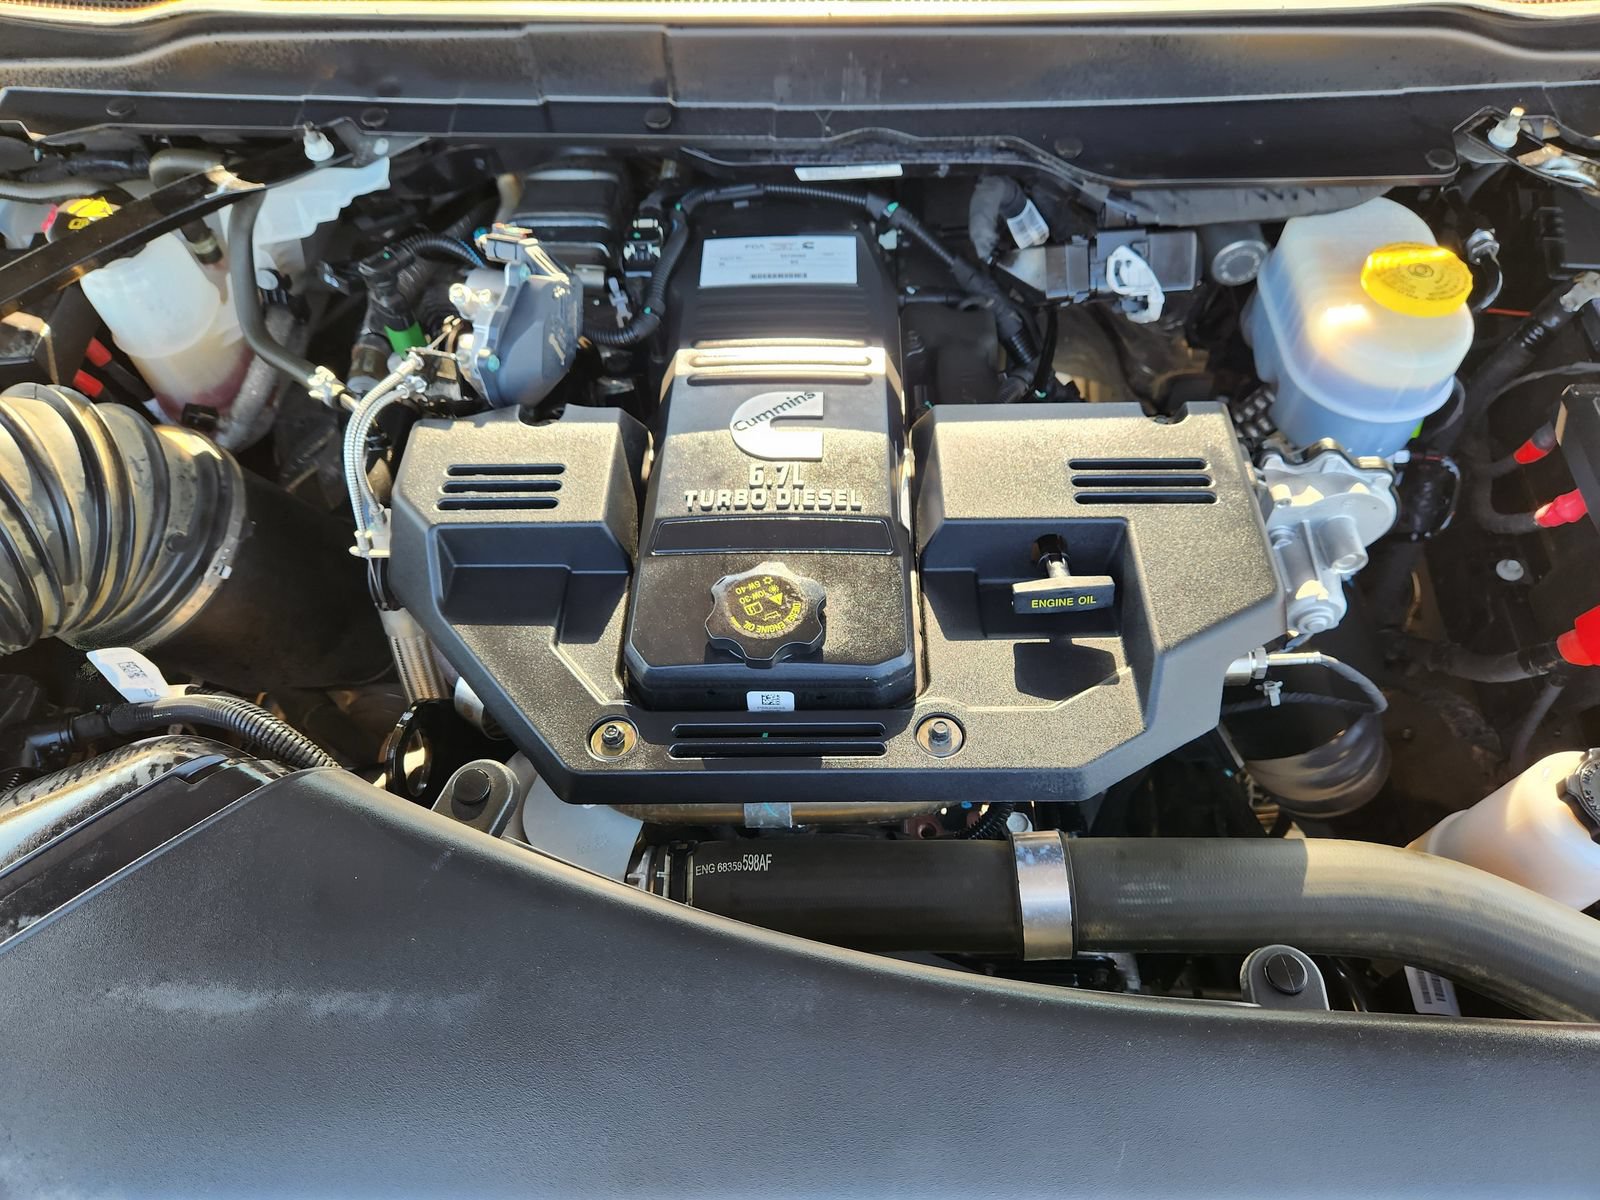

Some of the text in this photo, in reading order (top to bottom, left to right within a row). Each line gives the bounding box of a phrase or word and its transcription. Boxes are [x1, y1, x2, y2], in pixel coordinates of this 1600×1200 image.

[733, 391, 816, 431] Cummins
[749, 464, 805, 489] 6.7L
[684, 488, 863, 512] TURBO DIESEL
[1031, 595, 1097, 609] ENGINE OIL
[755, 622, 786, 634] ENGINE
[695, 853, 772, 876] ENG 68359598AF
